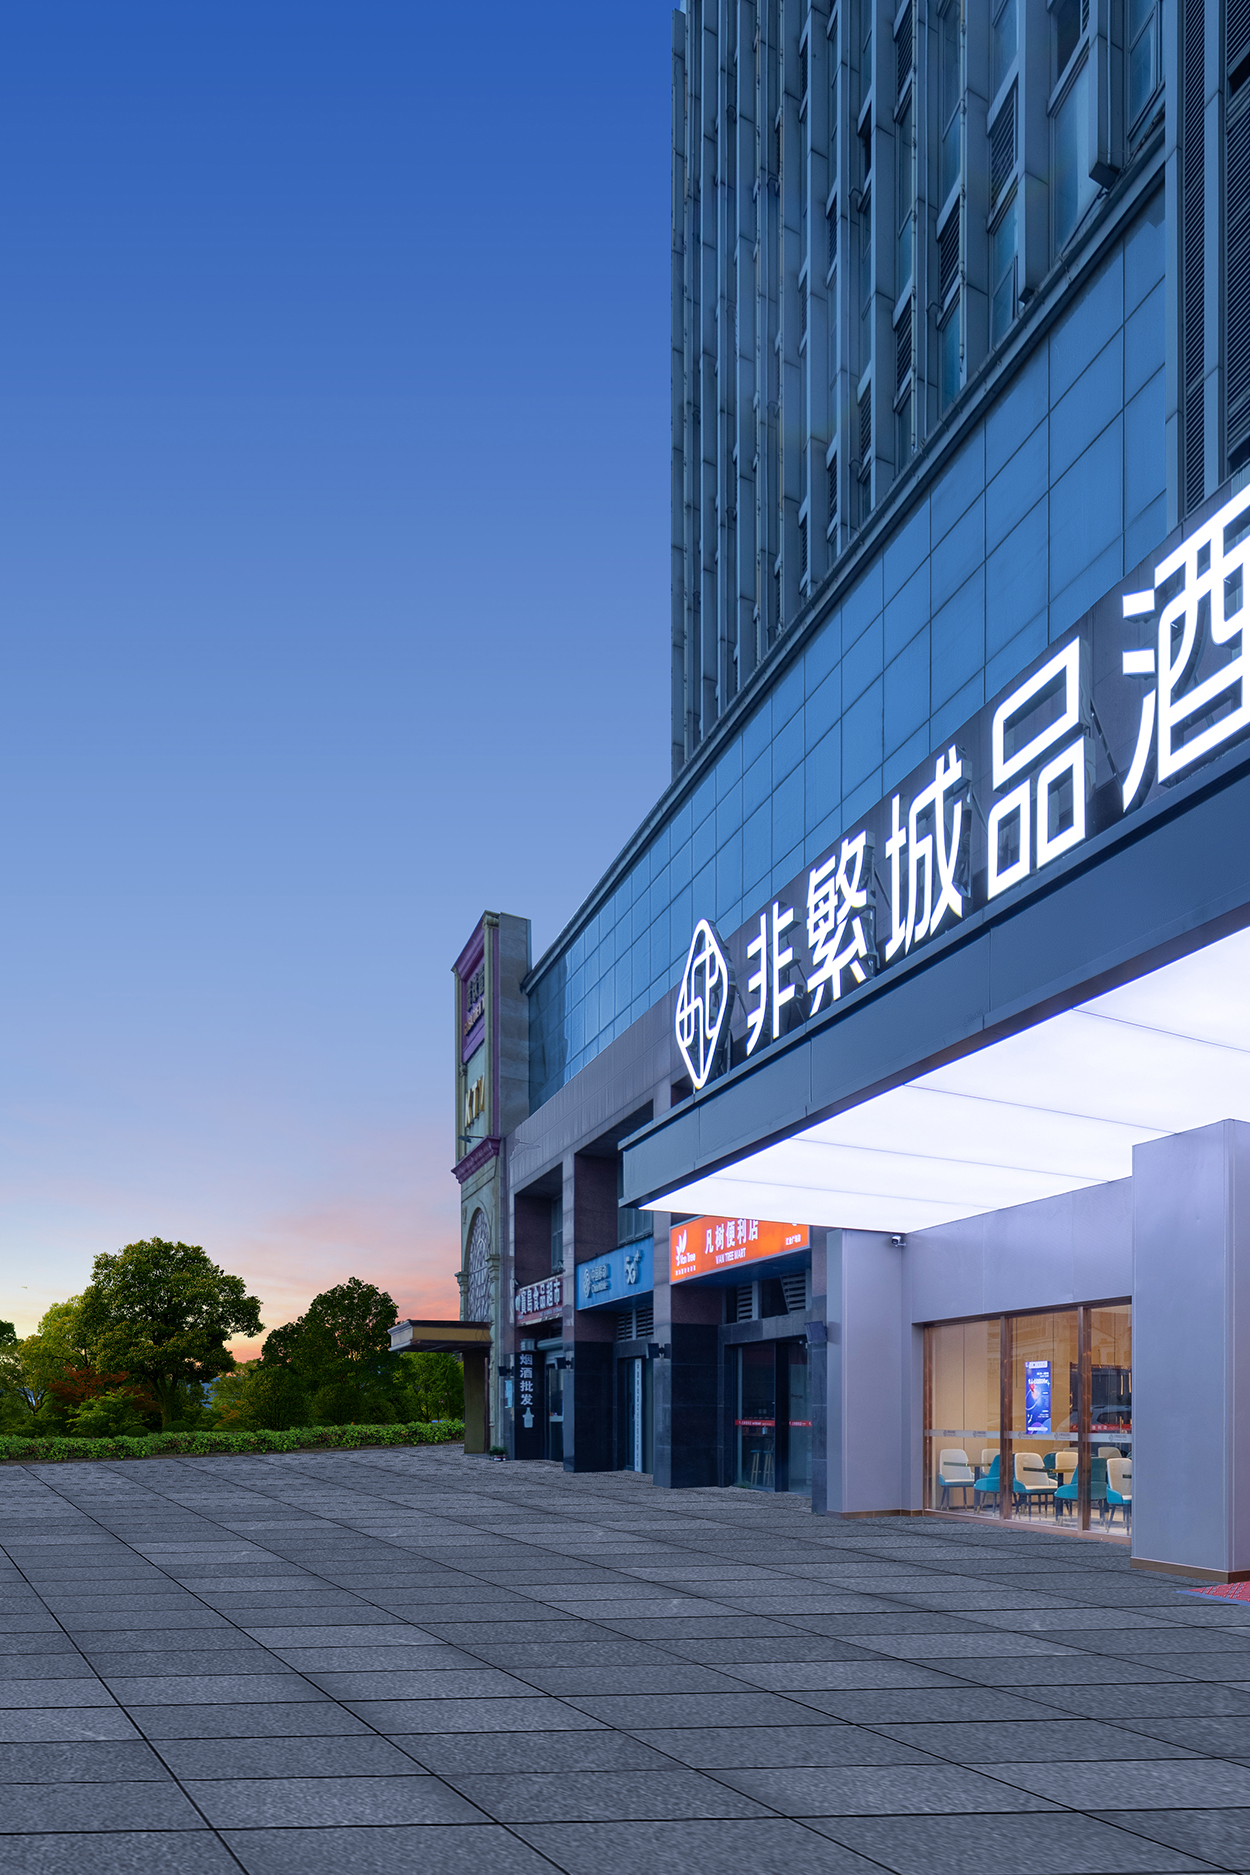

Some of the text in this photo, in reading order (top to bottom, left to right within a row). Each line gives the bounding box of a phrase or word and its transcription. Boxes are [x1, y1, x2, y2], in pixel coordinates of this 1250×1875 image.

[704, 1218, 759, 1255] 凡树便利店
[520, 1353, 534, 1406] 烟酒批发
